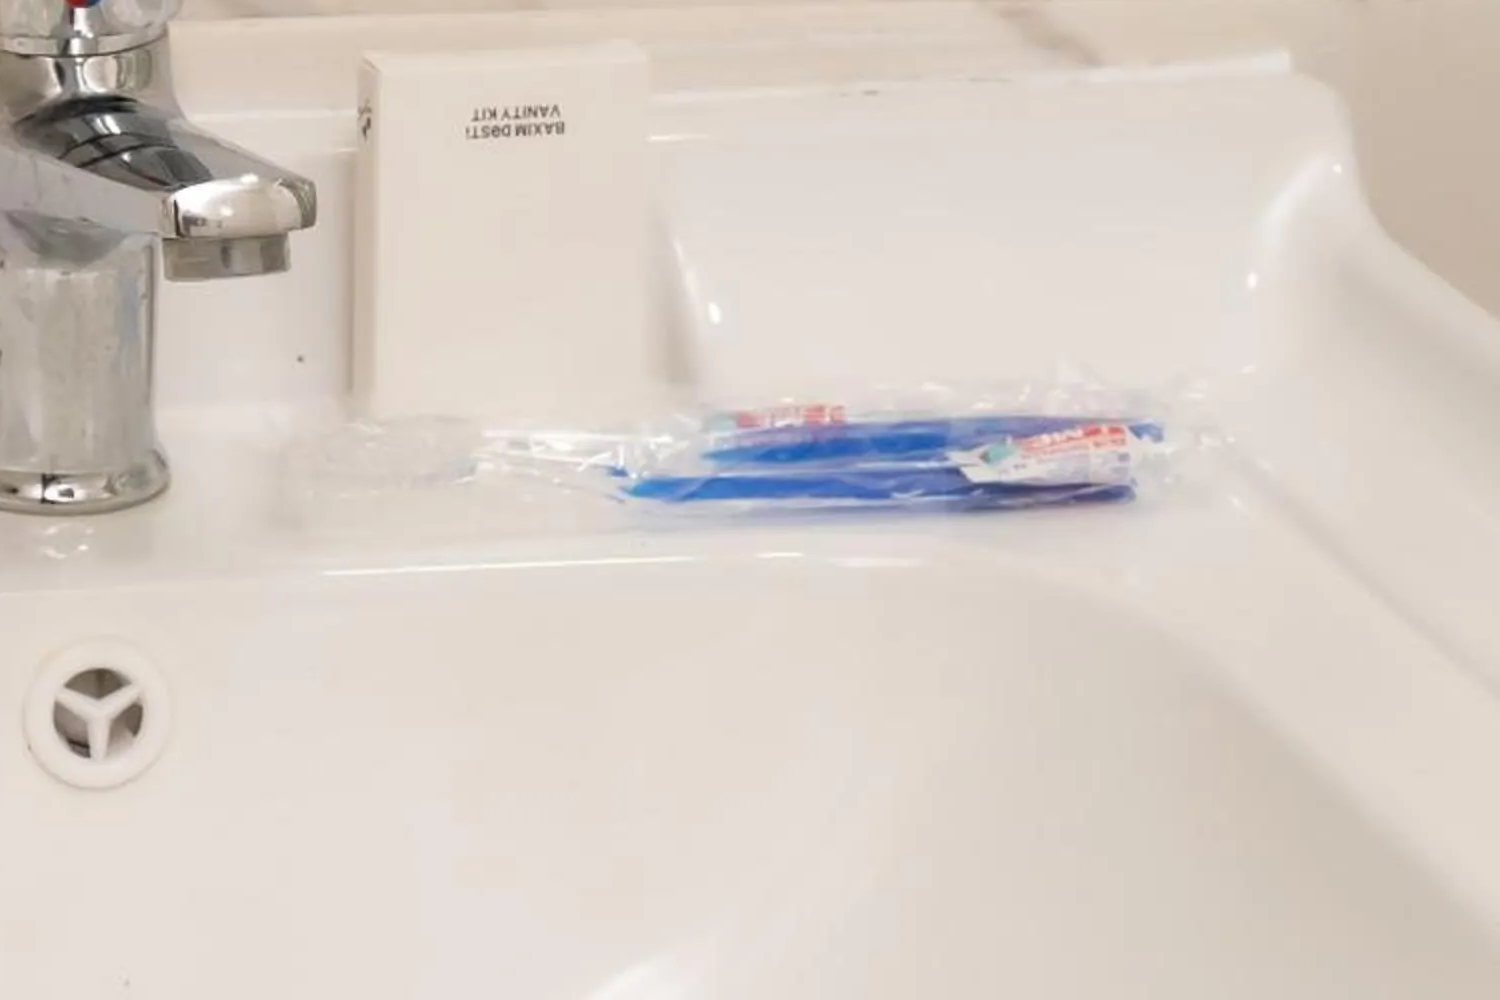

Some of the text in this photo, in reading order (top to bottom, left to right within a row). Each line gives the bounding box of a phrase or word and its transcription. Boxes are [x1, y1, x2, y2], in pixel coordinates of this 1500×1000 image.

[470, 104, 561, 122] VANITY KIT
[515, 121, 566, 137] BAXIM
